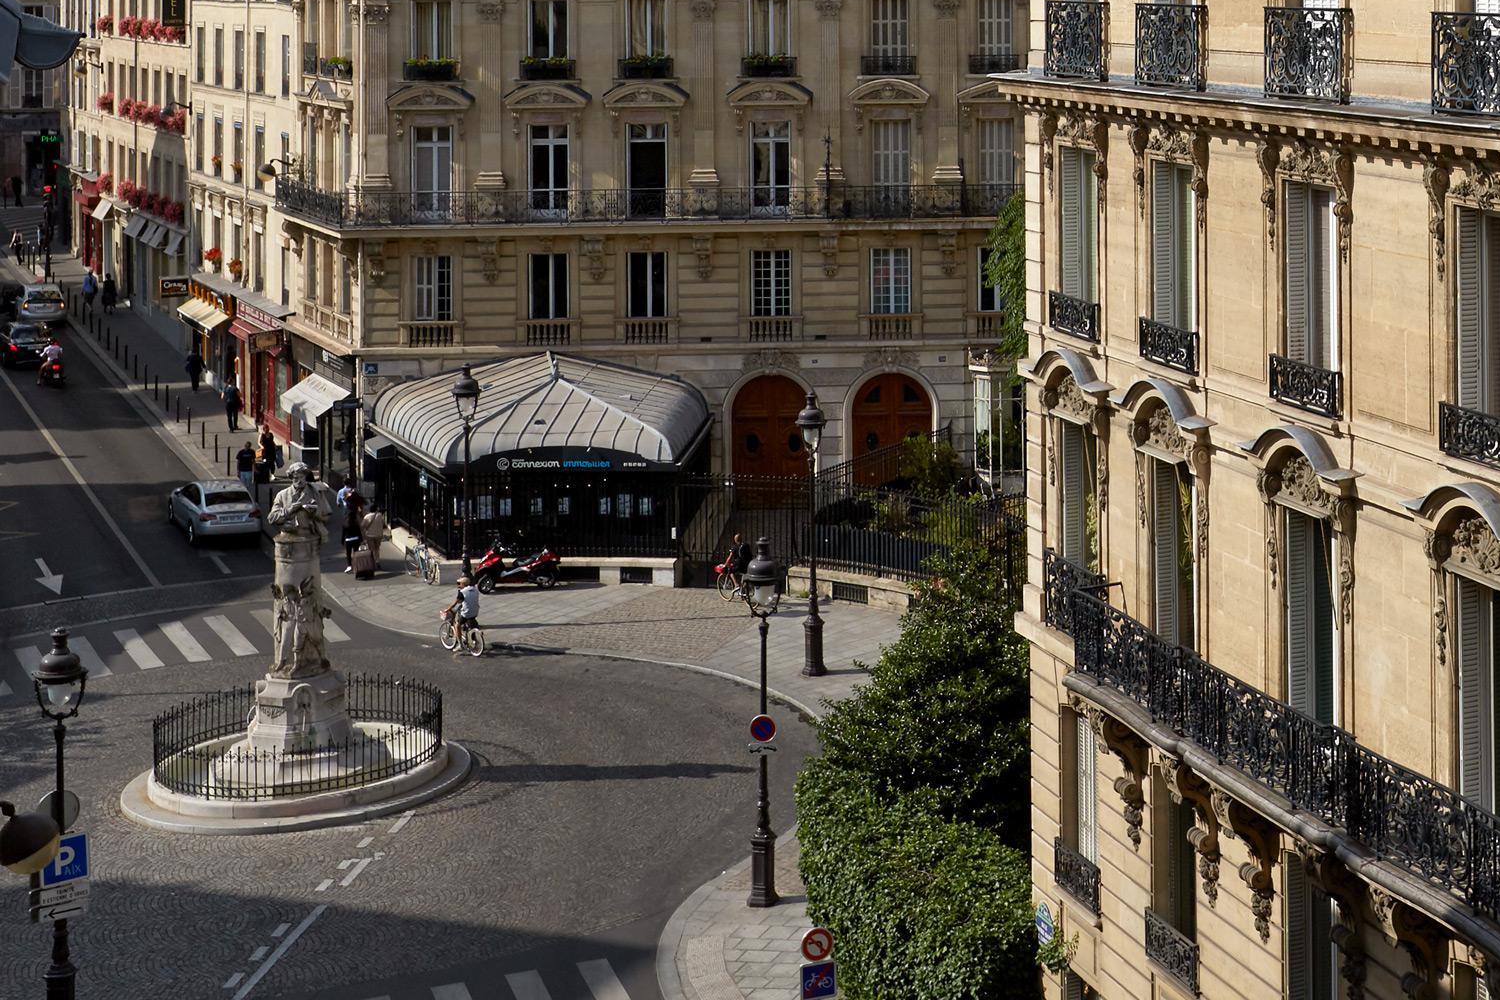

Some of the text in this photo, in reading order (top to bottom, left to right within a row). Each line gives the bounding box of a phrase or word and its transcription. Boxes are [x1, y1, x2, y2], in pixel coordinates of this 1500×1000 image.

[511, 460, 611, 468] connexion immobilier
[55, 846, 75, 876] P
